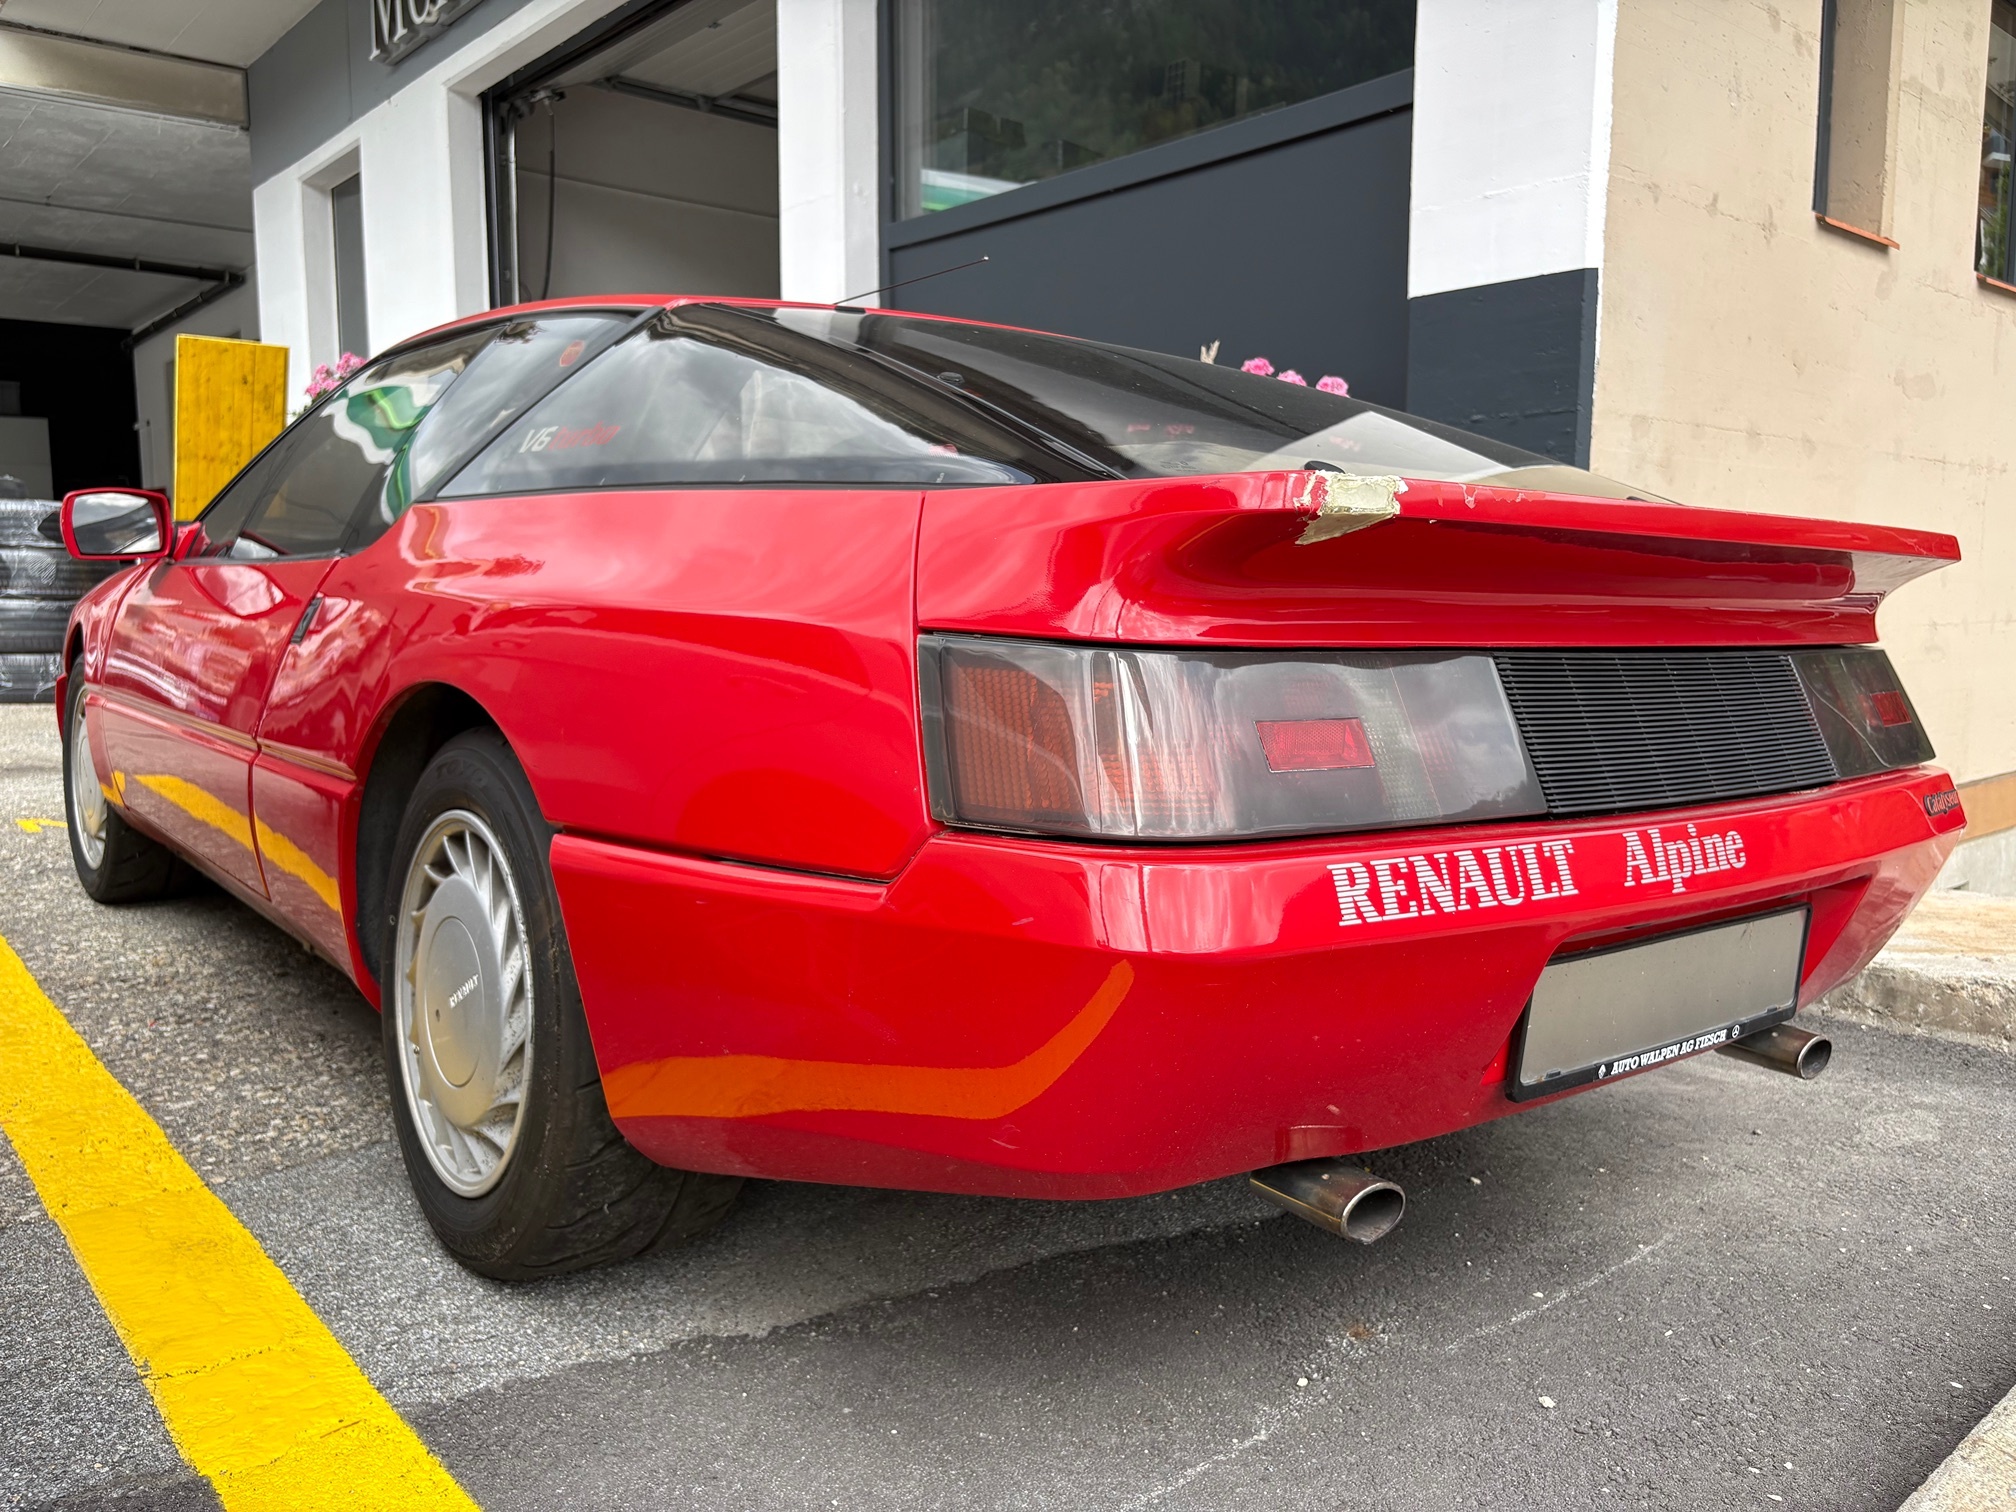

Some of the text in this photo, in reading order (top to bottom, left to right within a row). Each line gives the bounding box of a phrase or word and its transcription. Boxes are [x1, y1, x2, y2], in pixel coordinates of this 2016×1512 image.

[519, 426, 559, 453] V6
[1326, 824, 1747, 927] RENAULT Alpine
[1611, 1029, 1727, 1075] AUTO WALPEN AG FIESCH
